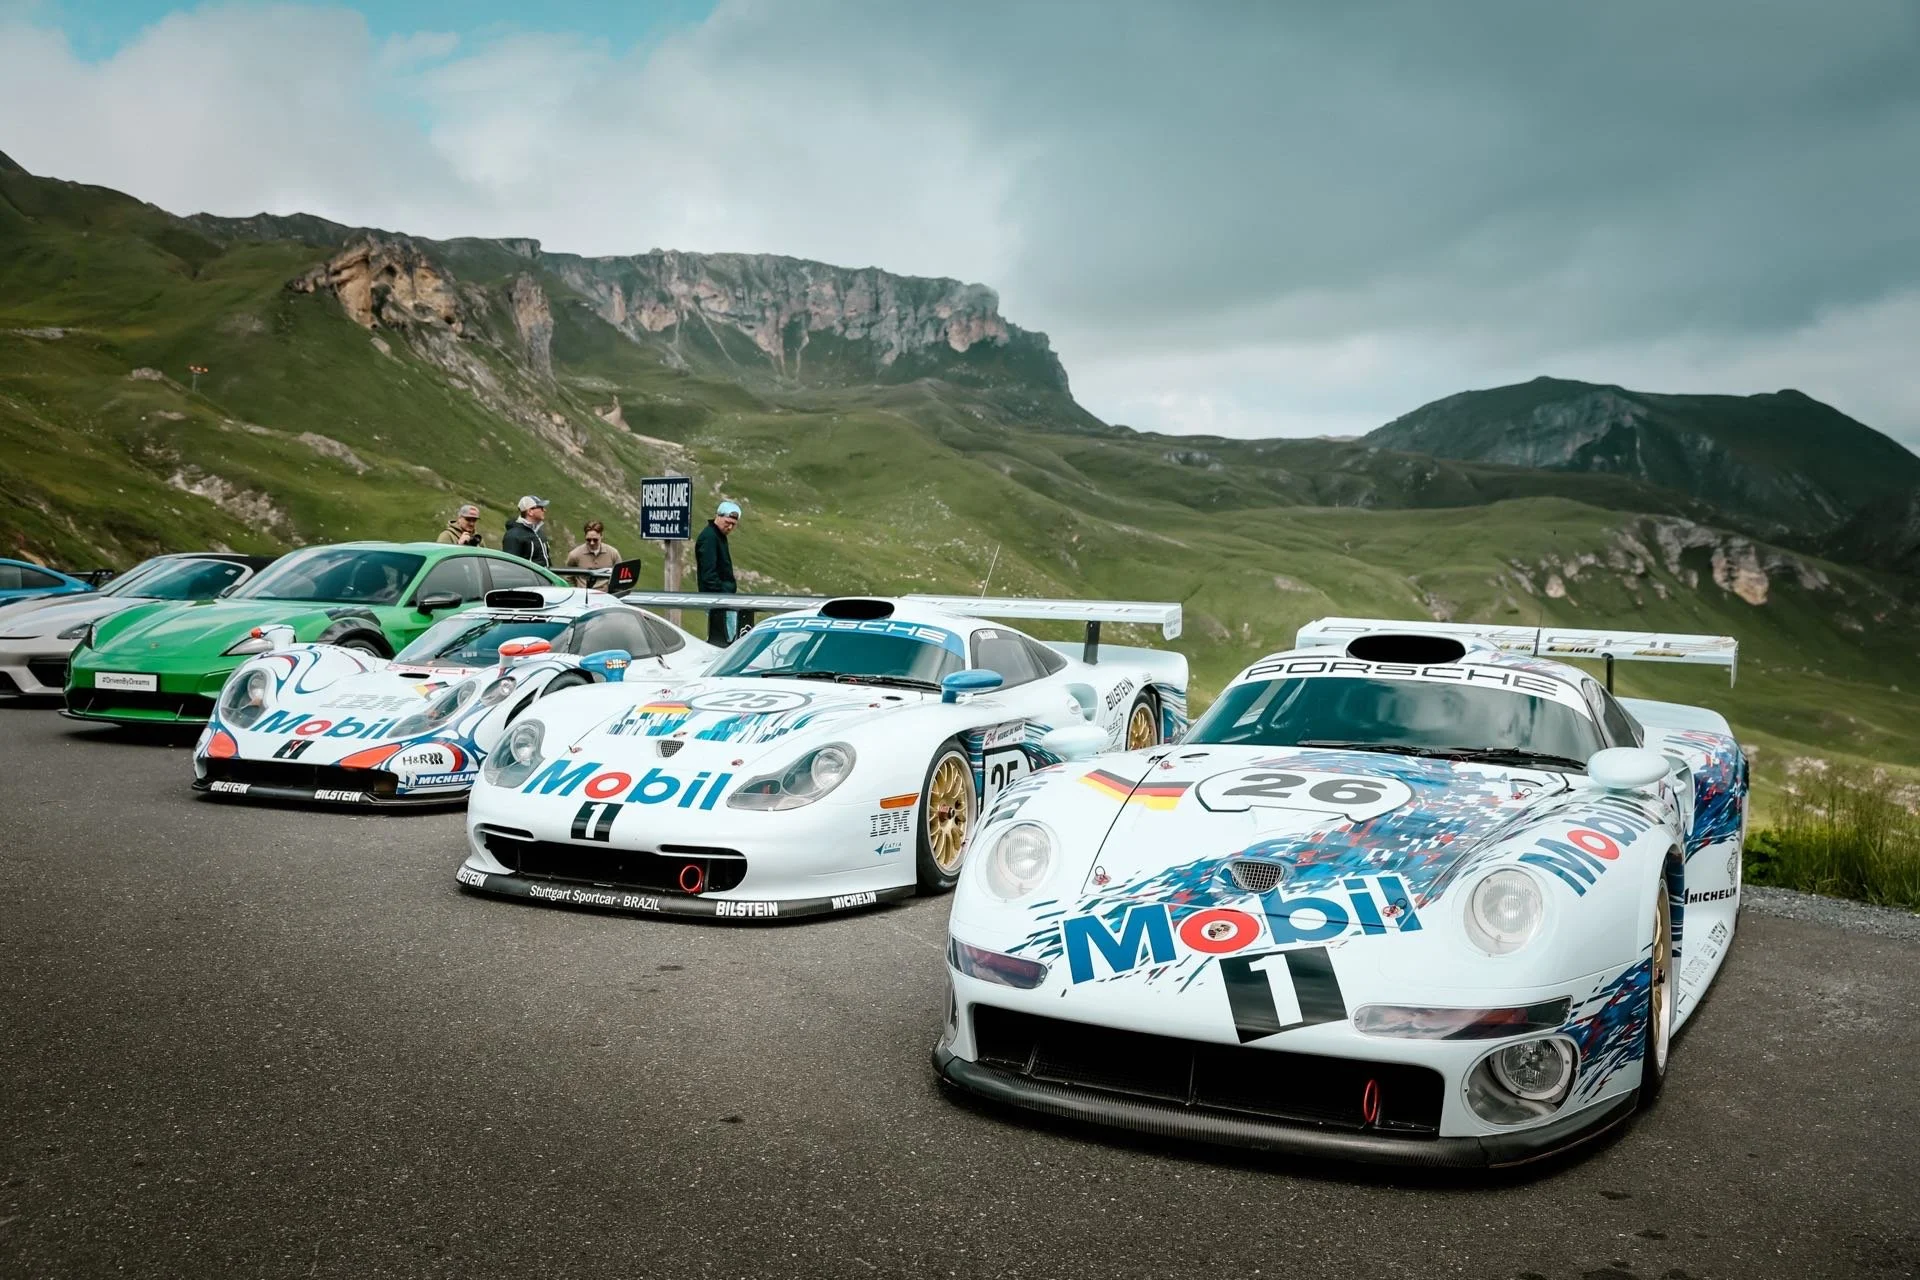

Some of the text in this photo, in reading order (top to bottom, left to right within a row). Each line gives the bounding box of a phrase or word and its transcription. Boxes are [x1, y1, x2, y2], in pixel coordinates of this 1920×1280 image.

[649, 510, 680, 520] PARKPLATZ
[620, 595, 825, 608] PORSCH
[753, 619, 948, 643] PORSCHE
[102, 676, 150, 687] #DrivenByDreams
[1245, 661, 1558, 697] PORSCHE
[705, 693, 789, 708] 25
[1105, 676, 1135, 711] BILSTEIN
[250, 710, 402, 739] Mobil
[402, 753, 429, 766] H&R
[211, 781, 362, 802] BILSTEIN BILSTEIN
[522, 759, 733, 811] Mobil
[1222, 773, 1389, 805] 26
[583, 803, 609, 839] 1
[870, 810, 910, 837] IBM
[1518, 805, 1652, 897] Mobil
[529, 884, 661, 911] Stuttgart Sportcar BRAZIL
[716, 891, 877, 916] BILSTEIN MICHELIN
[1690, 886, 1737, 904] MICHELIN
[1063, 872, 1423, 985] Mobil
[1248, 953, 1304, 1027] 1
